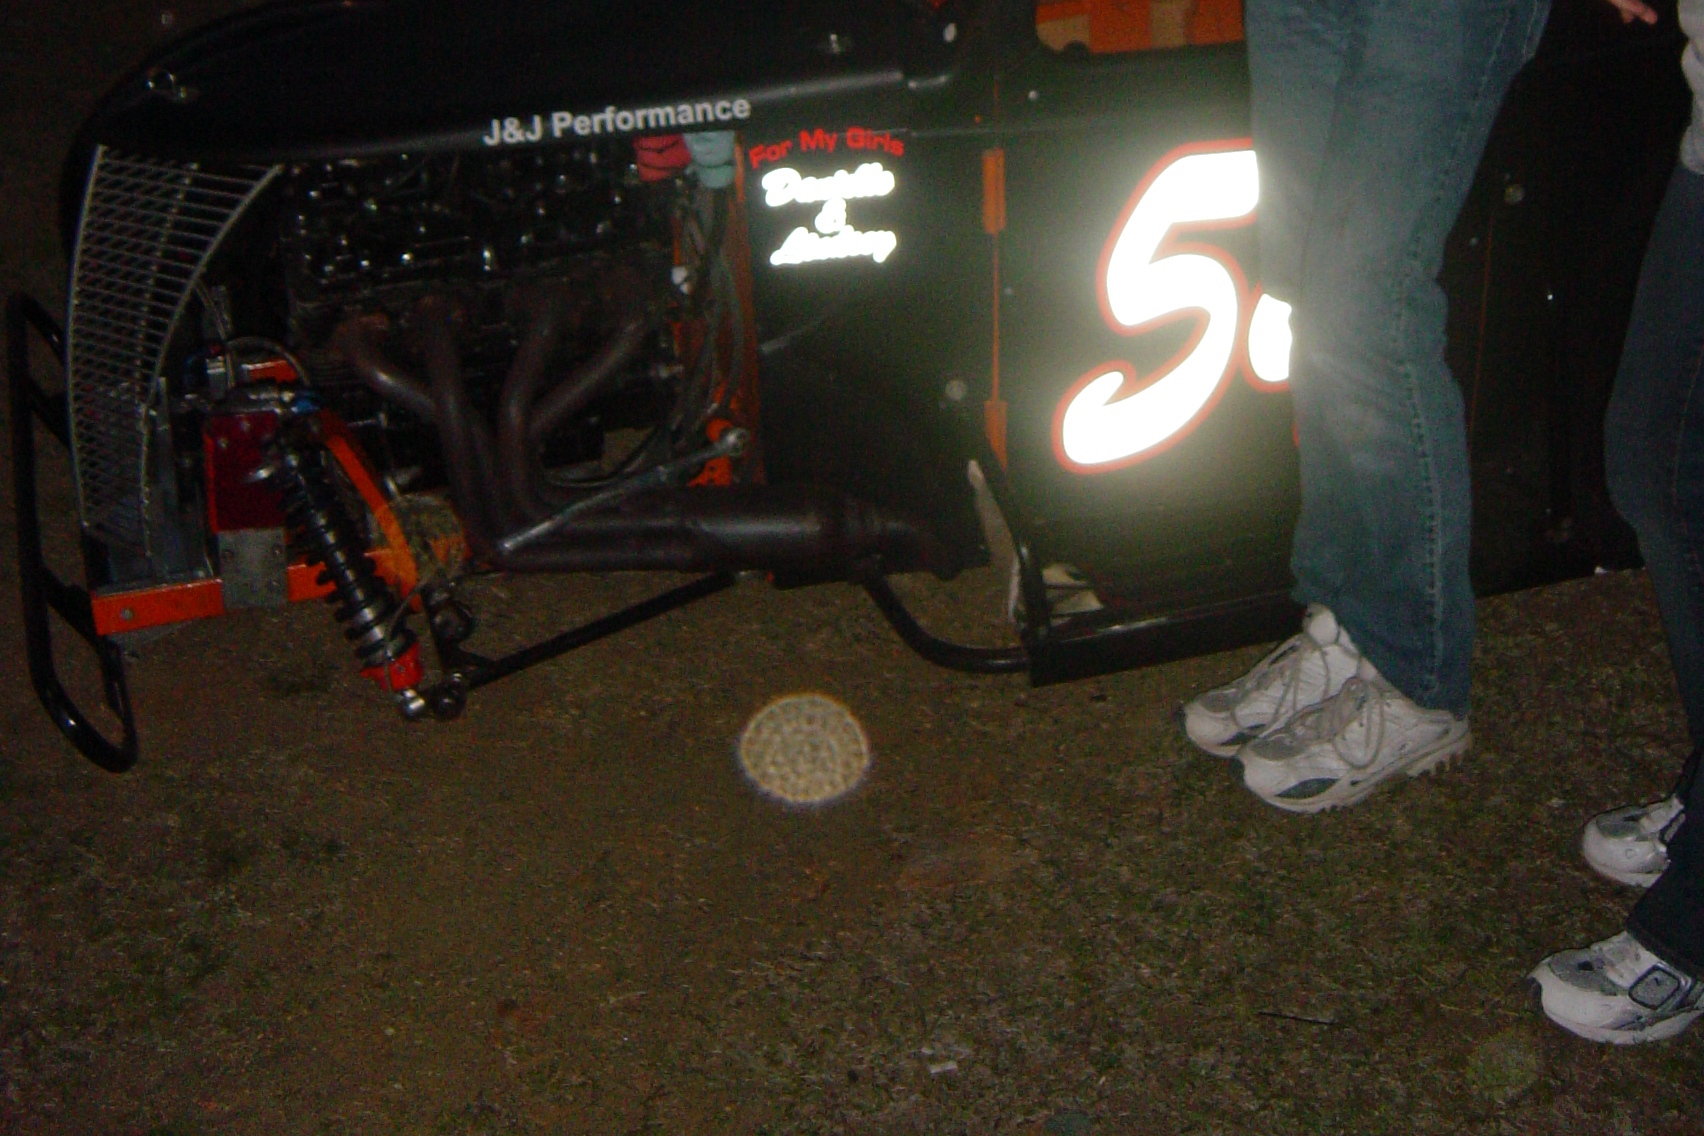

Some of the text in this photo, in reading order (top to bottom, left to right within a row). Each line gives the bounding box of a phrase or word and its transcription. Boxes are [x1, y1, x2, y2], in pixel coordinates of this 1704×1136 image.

[482, 98, 752, 146] J&J Performance
[749, 126, 905, 169] For My Girls
